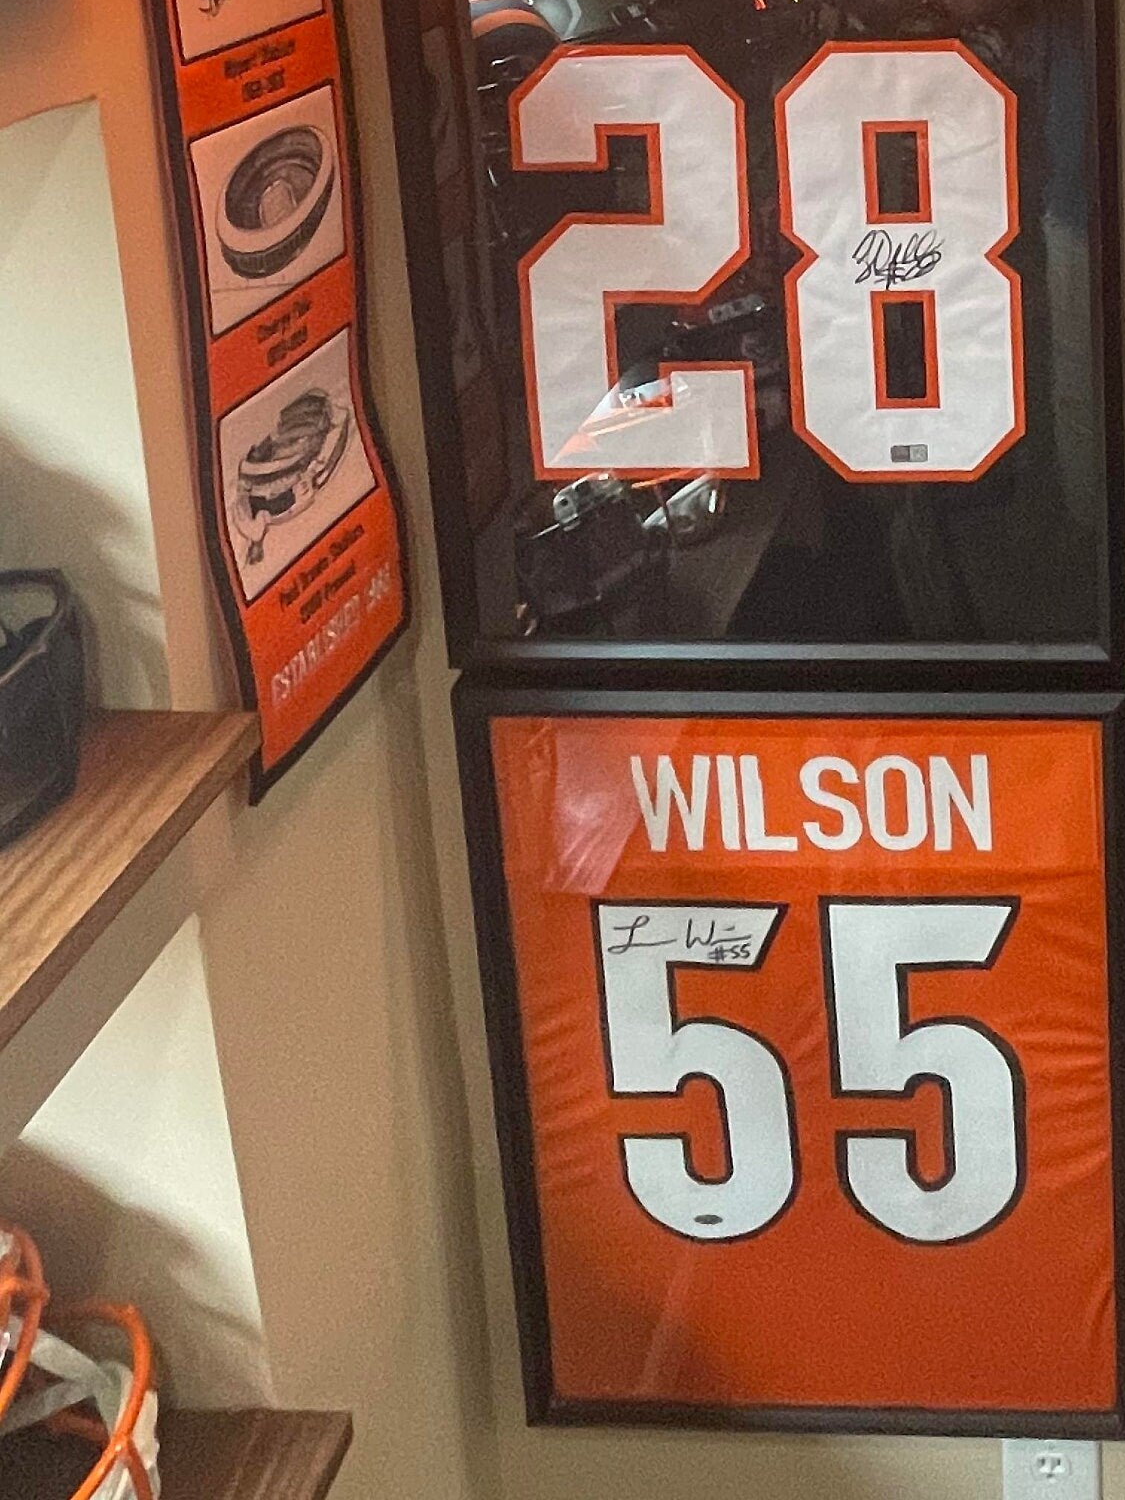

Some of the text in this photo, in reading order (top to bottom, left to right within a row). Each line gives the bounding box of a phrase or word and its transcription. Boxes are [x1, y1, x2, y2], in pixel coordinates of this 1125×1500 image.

[509, 40, 1026, 483] 28
[630, 754, 993, 852] WILSON
[591, 895, 1028, 1247] 55
